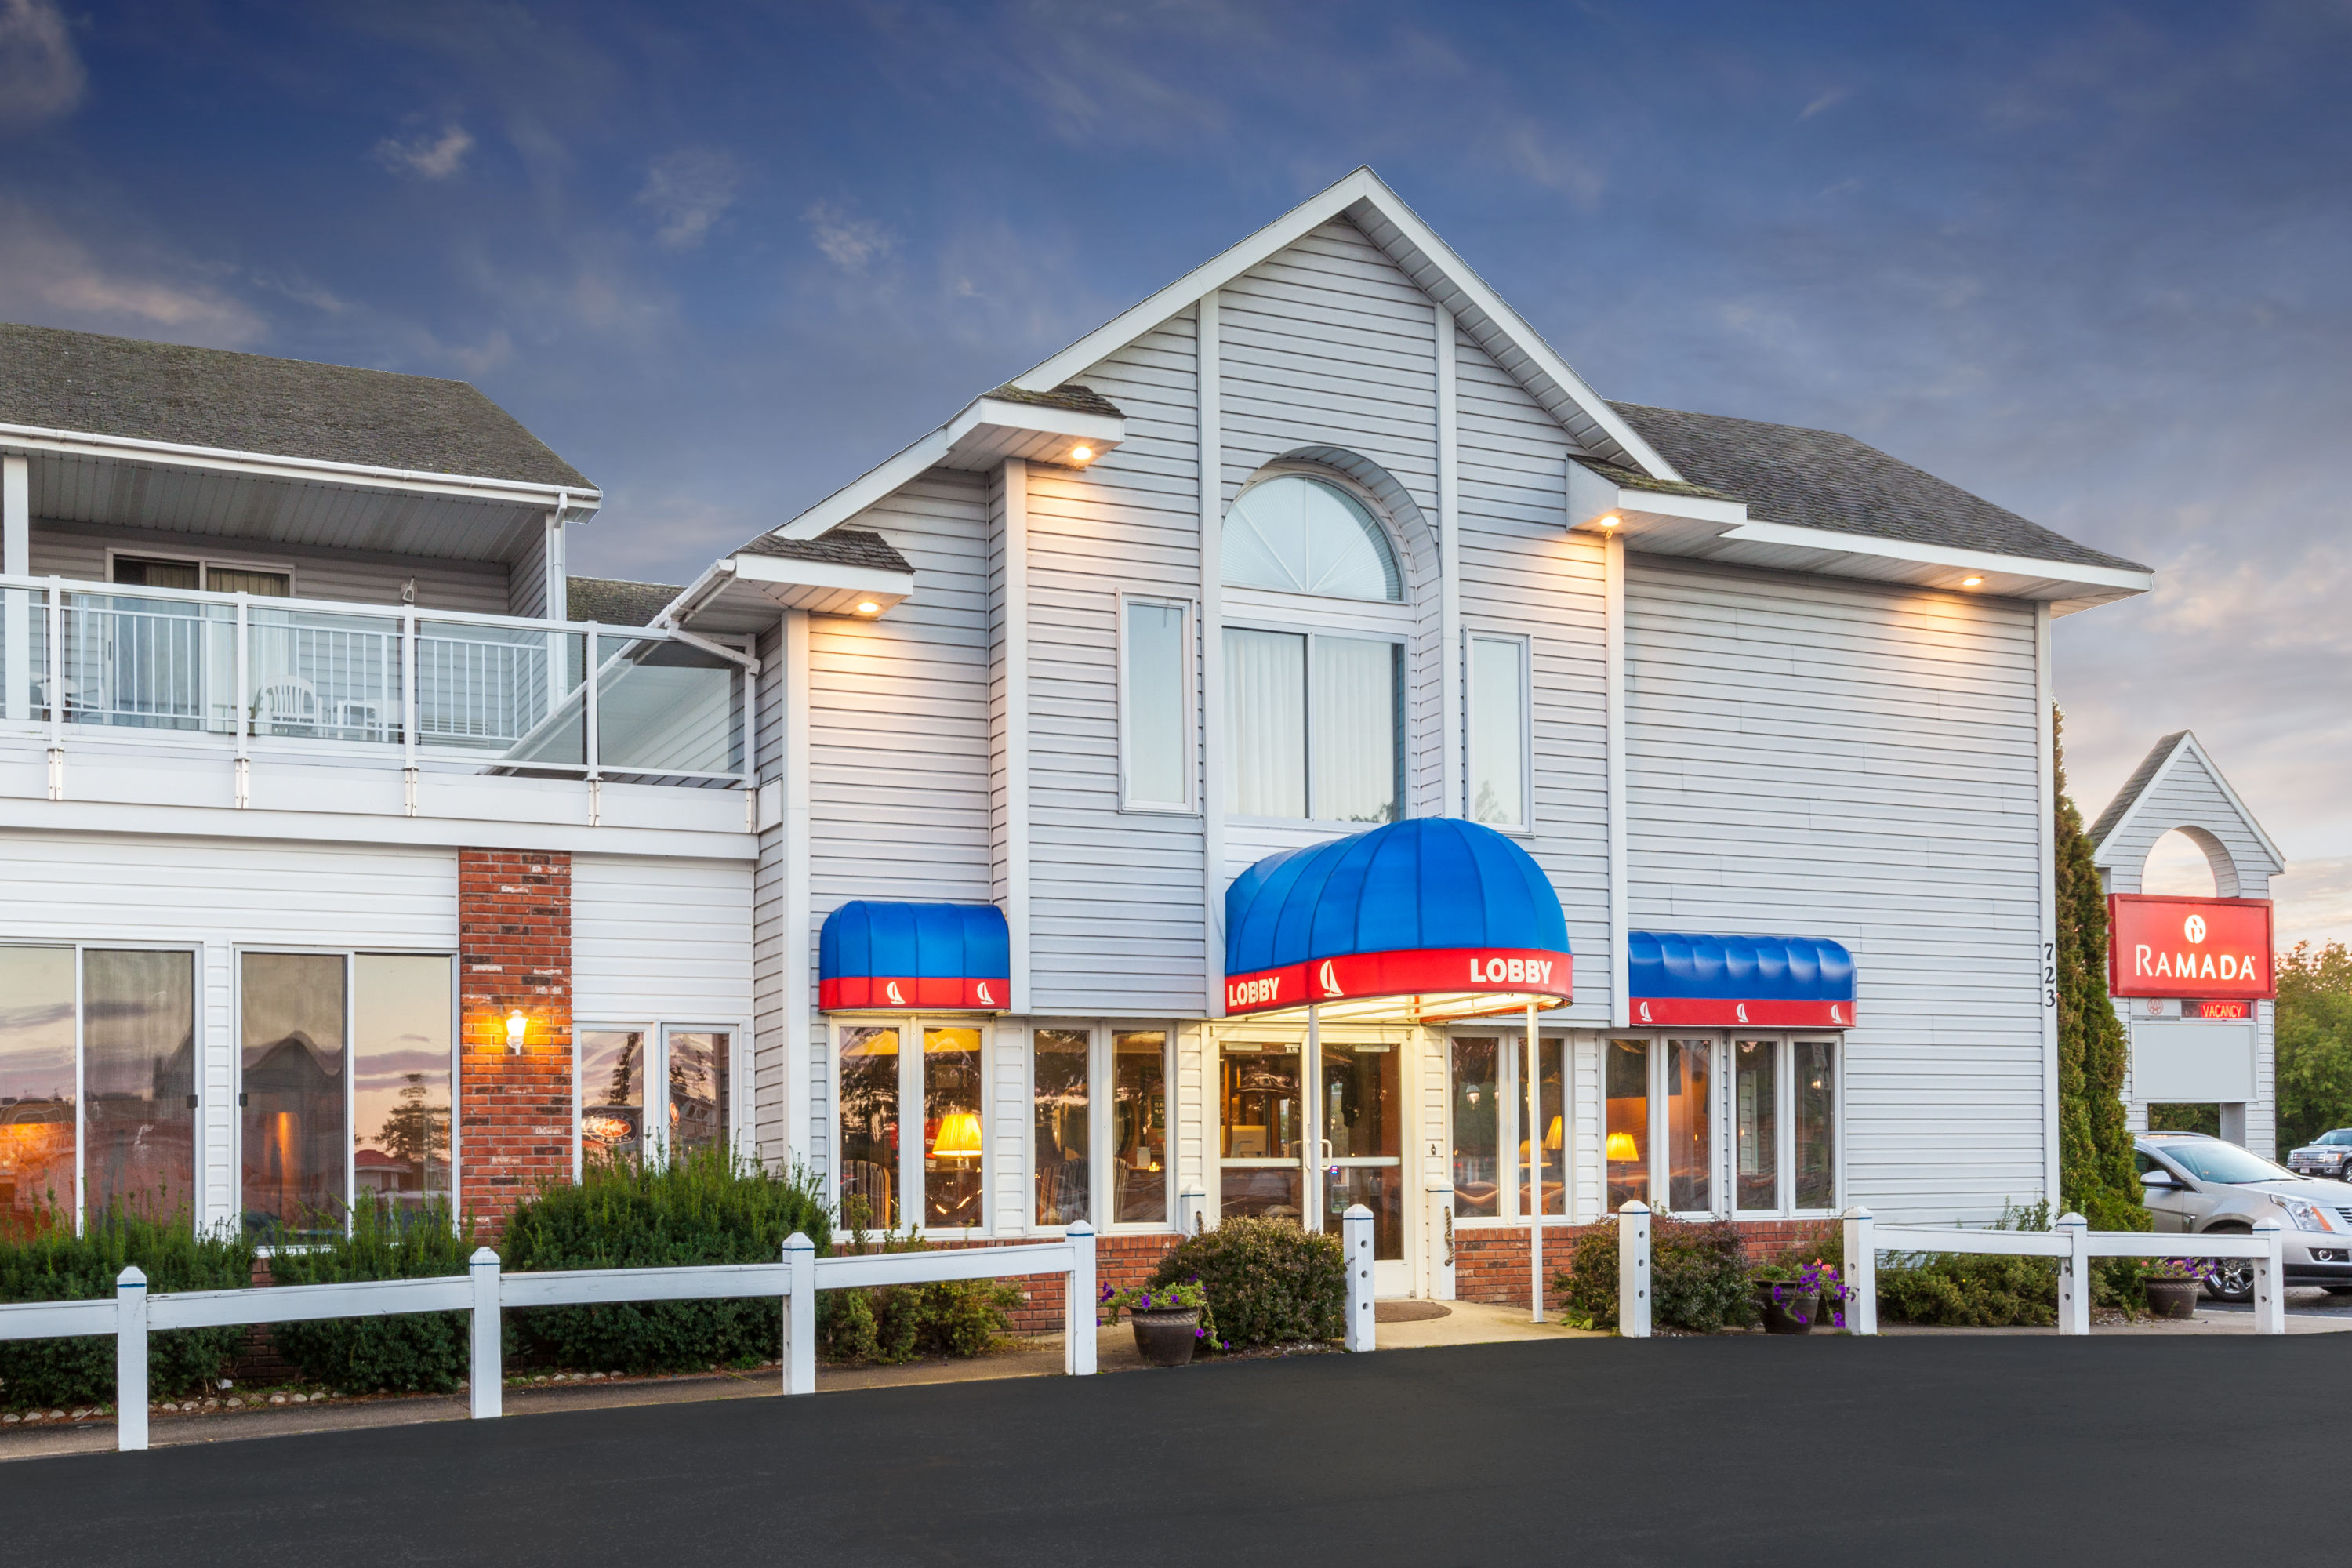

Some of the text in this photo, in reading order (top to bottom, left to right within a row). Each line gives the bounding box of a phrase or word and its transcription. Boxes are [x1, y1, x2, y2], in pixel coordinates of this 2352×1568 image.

[1471, 957, 1552, 985] LOBBY
[2044, 943, 2056, 1007] 723
[2136, 944, 2256, 980] RAMADA
[1229, 977, 1280, 1007] LOBBY
[2202, 1004, 2242, 1018] VACANCY
